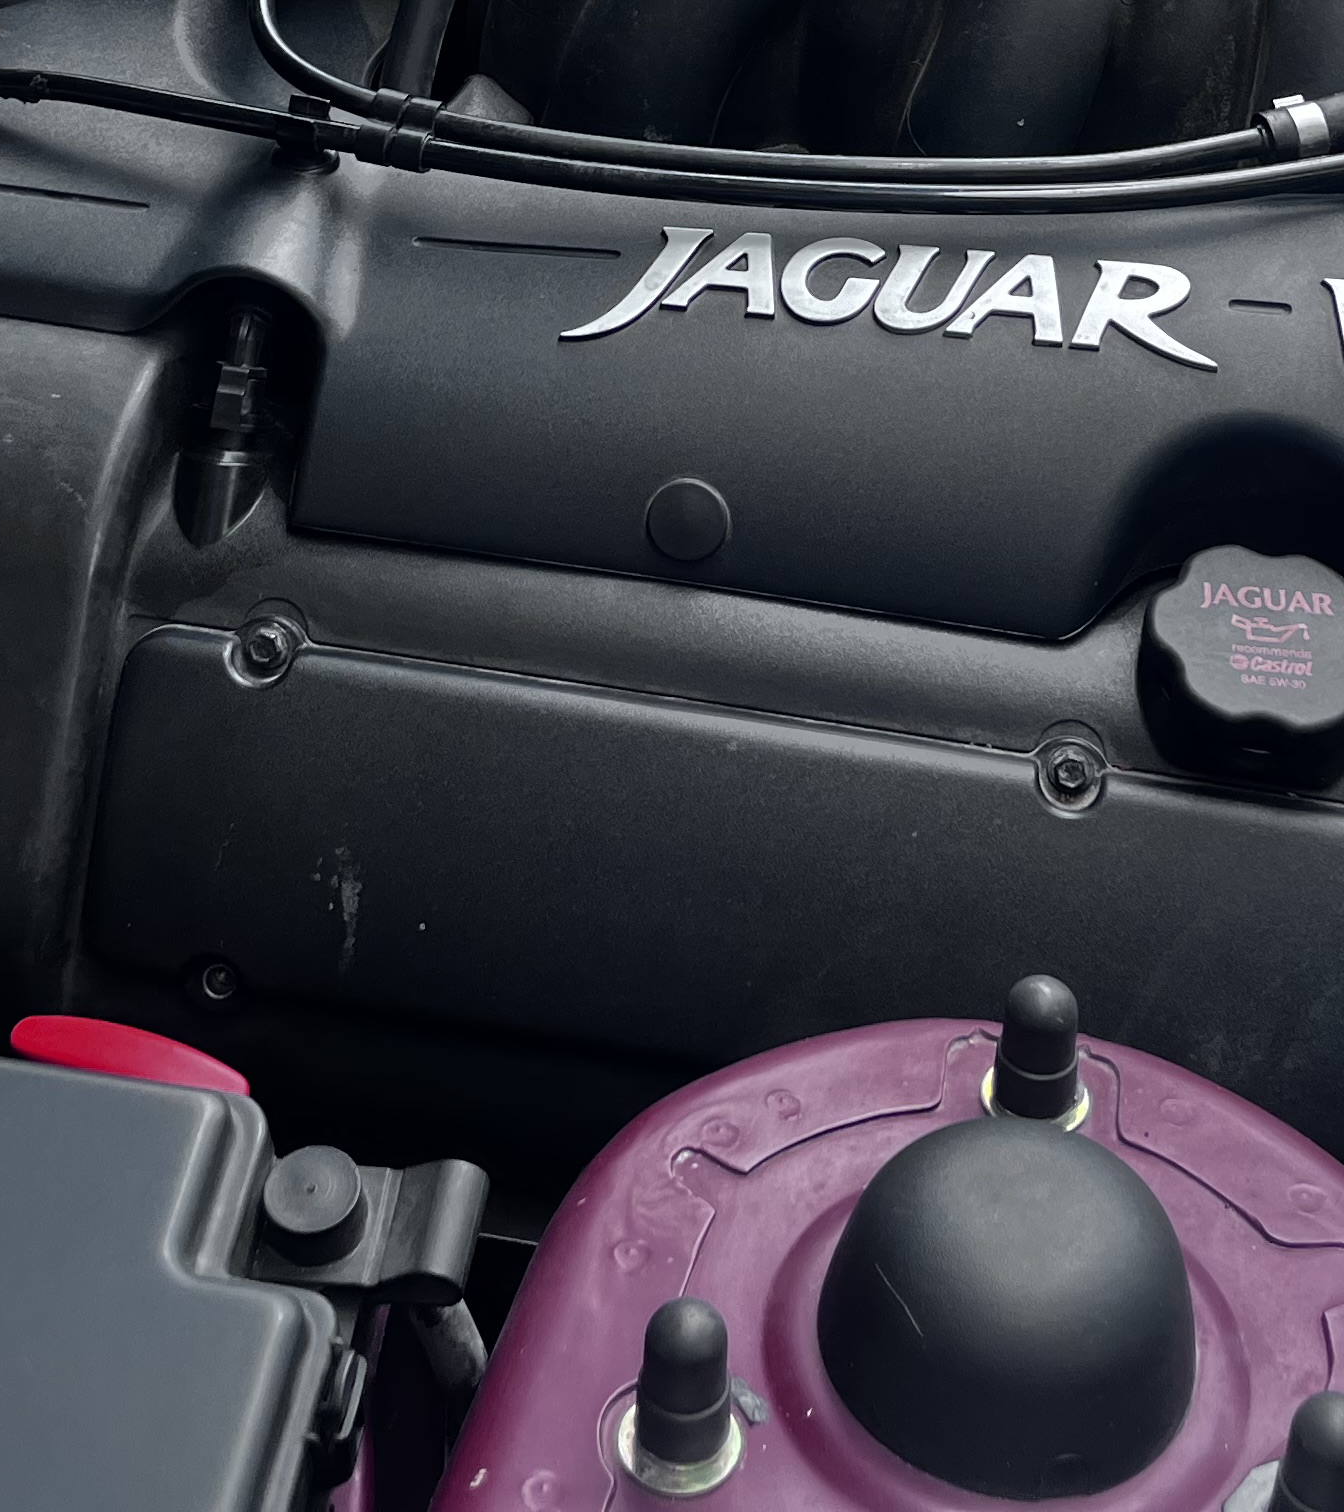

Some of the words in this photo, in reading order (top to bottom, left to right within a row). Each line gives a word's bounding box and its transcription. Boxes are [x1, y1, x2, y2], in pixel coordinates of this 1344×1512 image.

[558, 226, 1218, 373] JAGUAR
[1199, 581, 1335, 617] JAGUAR
[1231, 643, 1313, 659] recommends
[1250, 655, 1313, 676] Castrol
[1240, 673, 1267, 686] SAE
[1268, 676, 1307, 689] 5W-30
